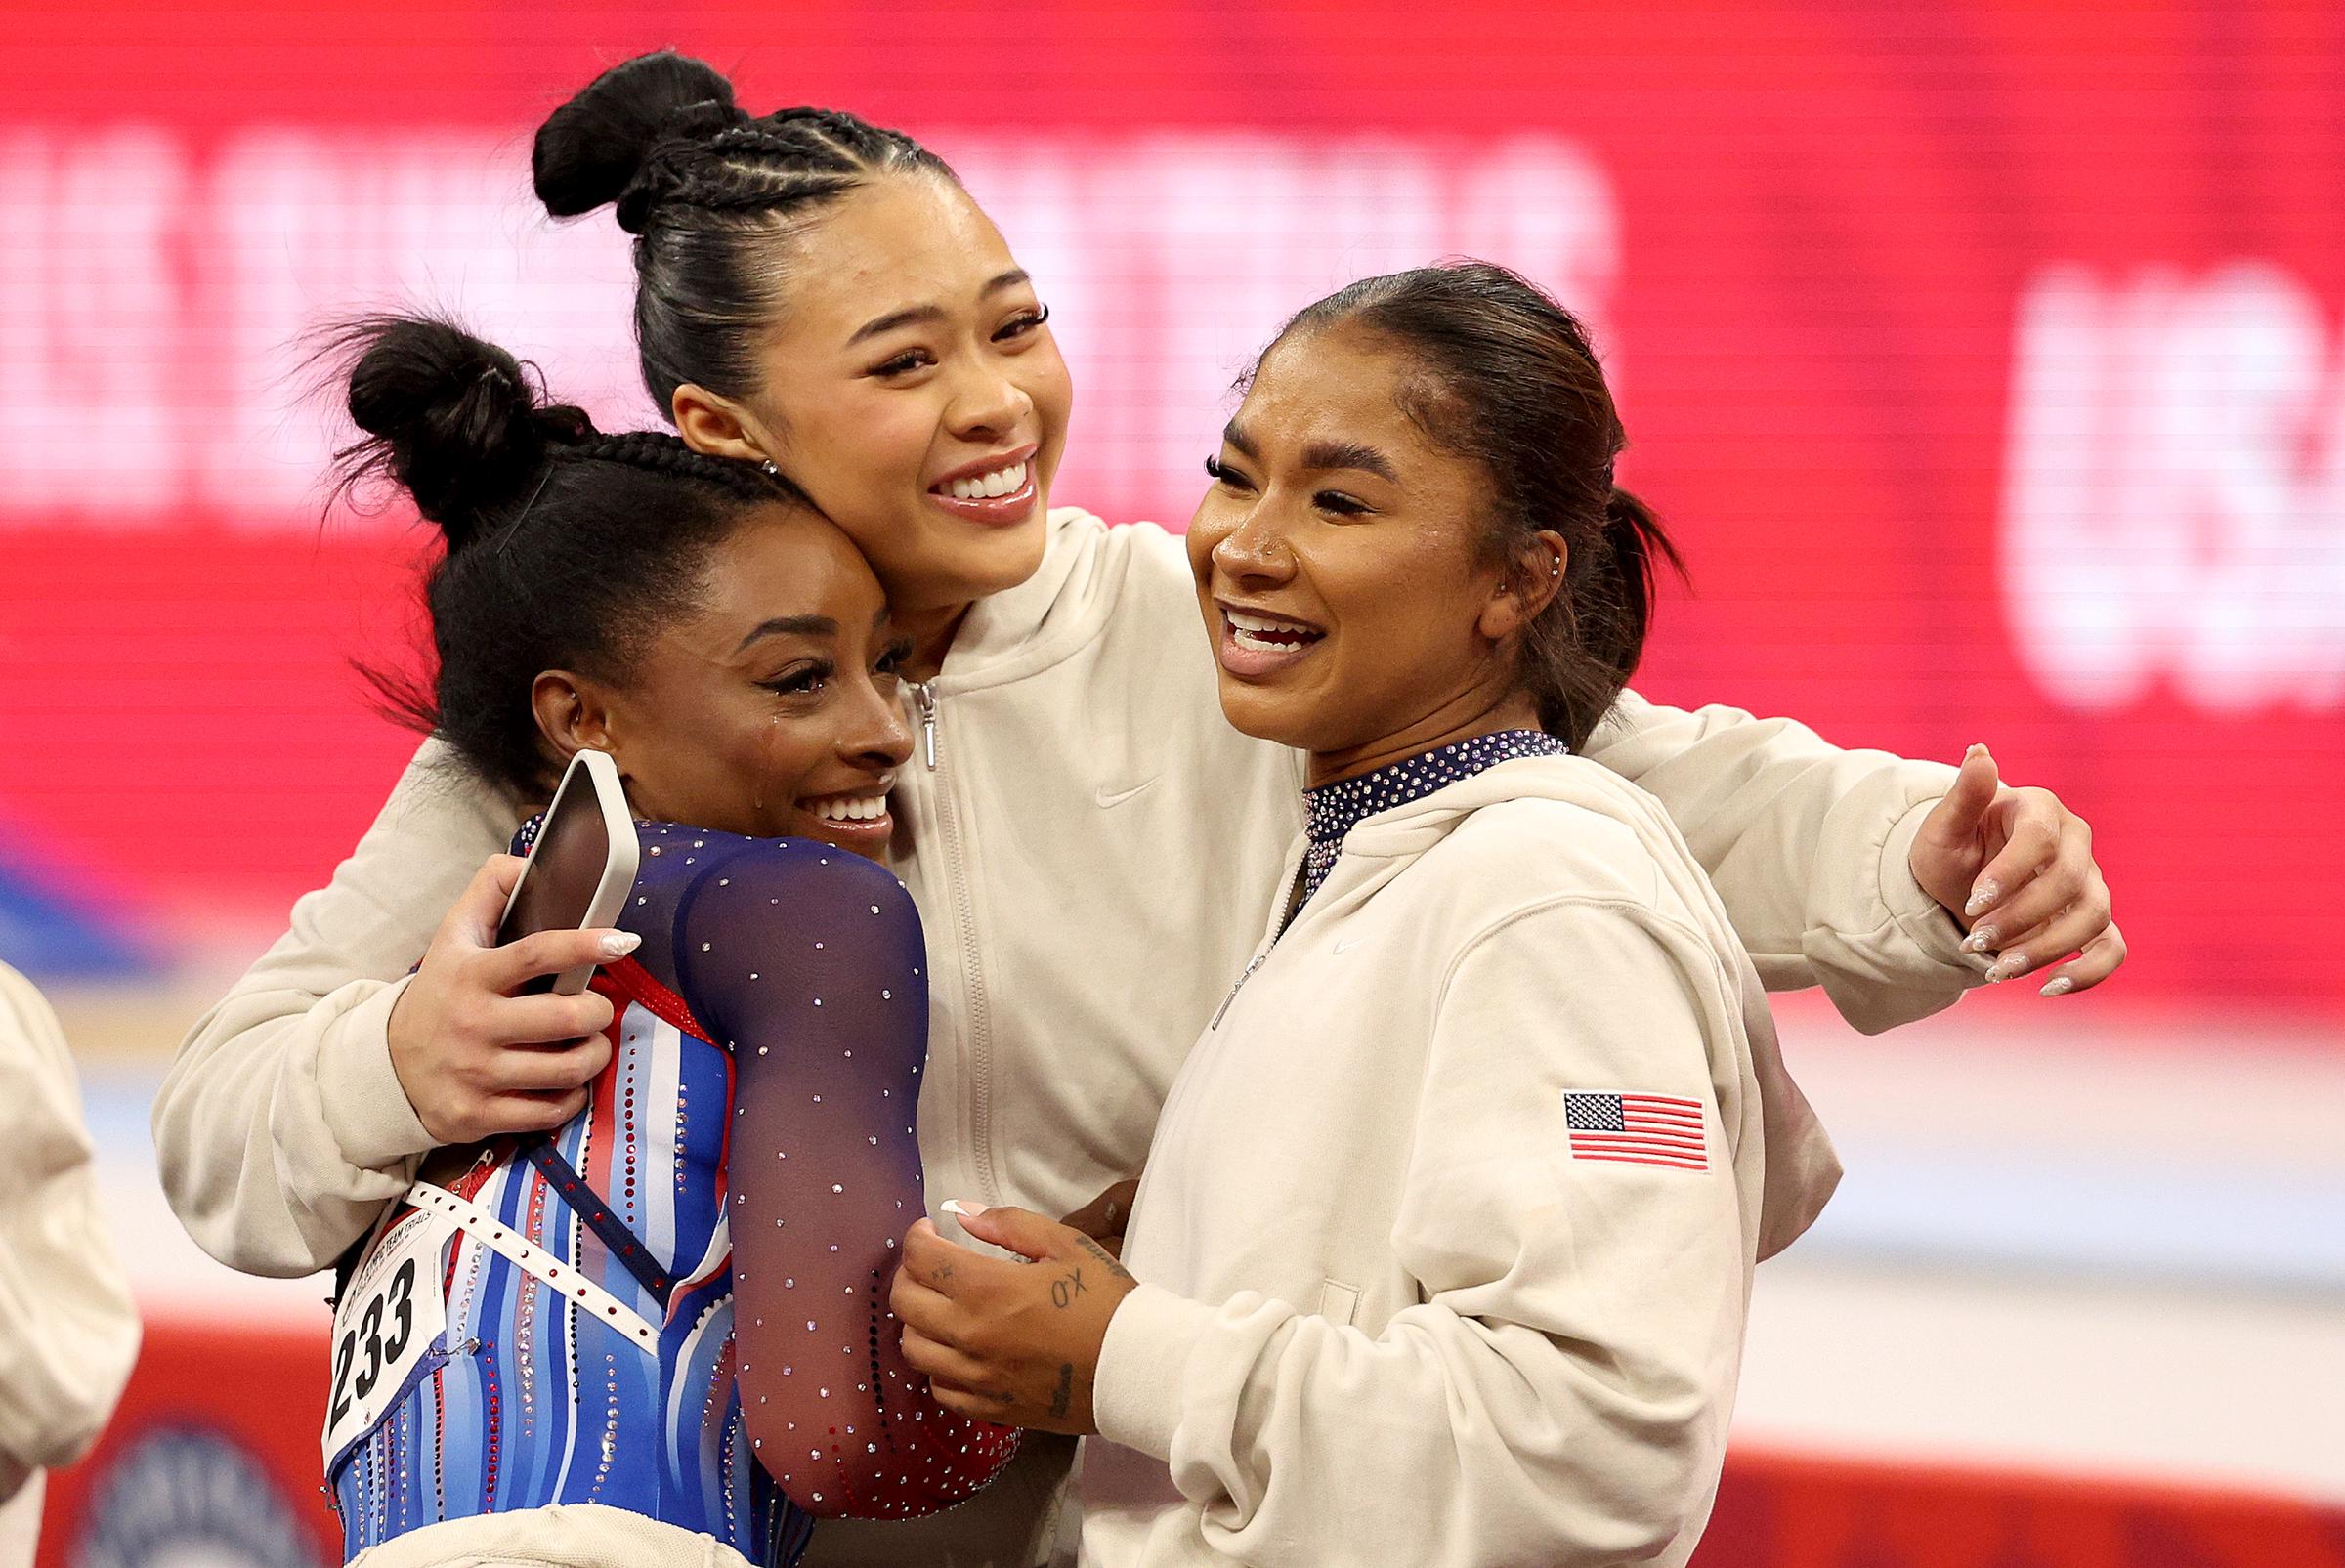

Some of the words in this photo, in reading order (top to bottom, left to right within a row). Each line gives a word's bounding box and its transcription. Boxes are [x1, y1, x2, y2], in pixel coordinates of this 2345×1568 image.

[386, 1227, 404, 1251] TEAM
[404, 1212, 431, 1235] TRIALS
[328, 1257, 415, 1441] 233
